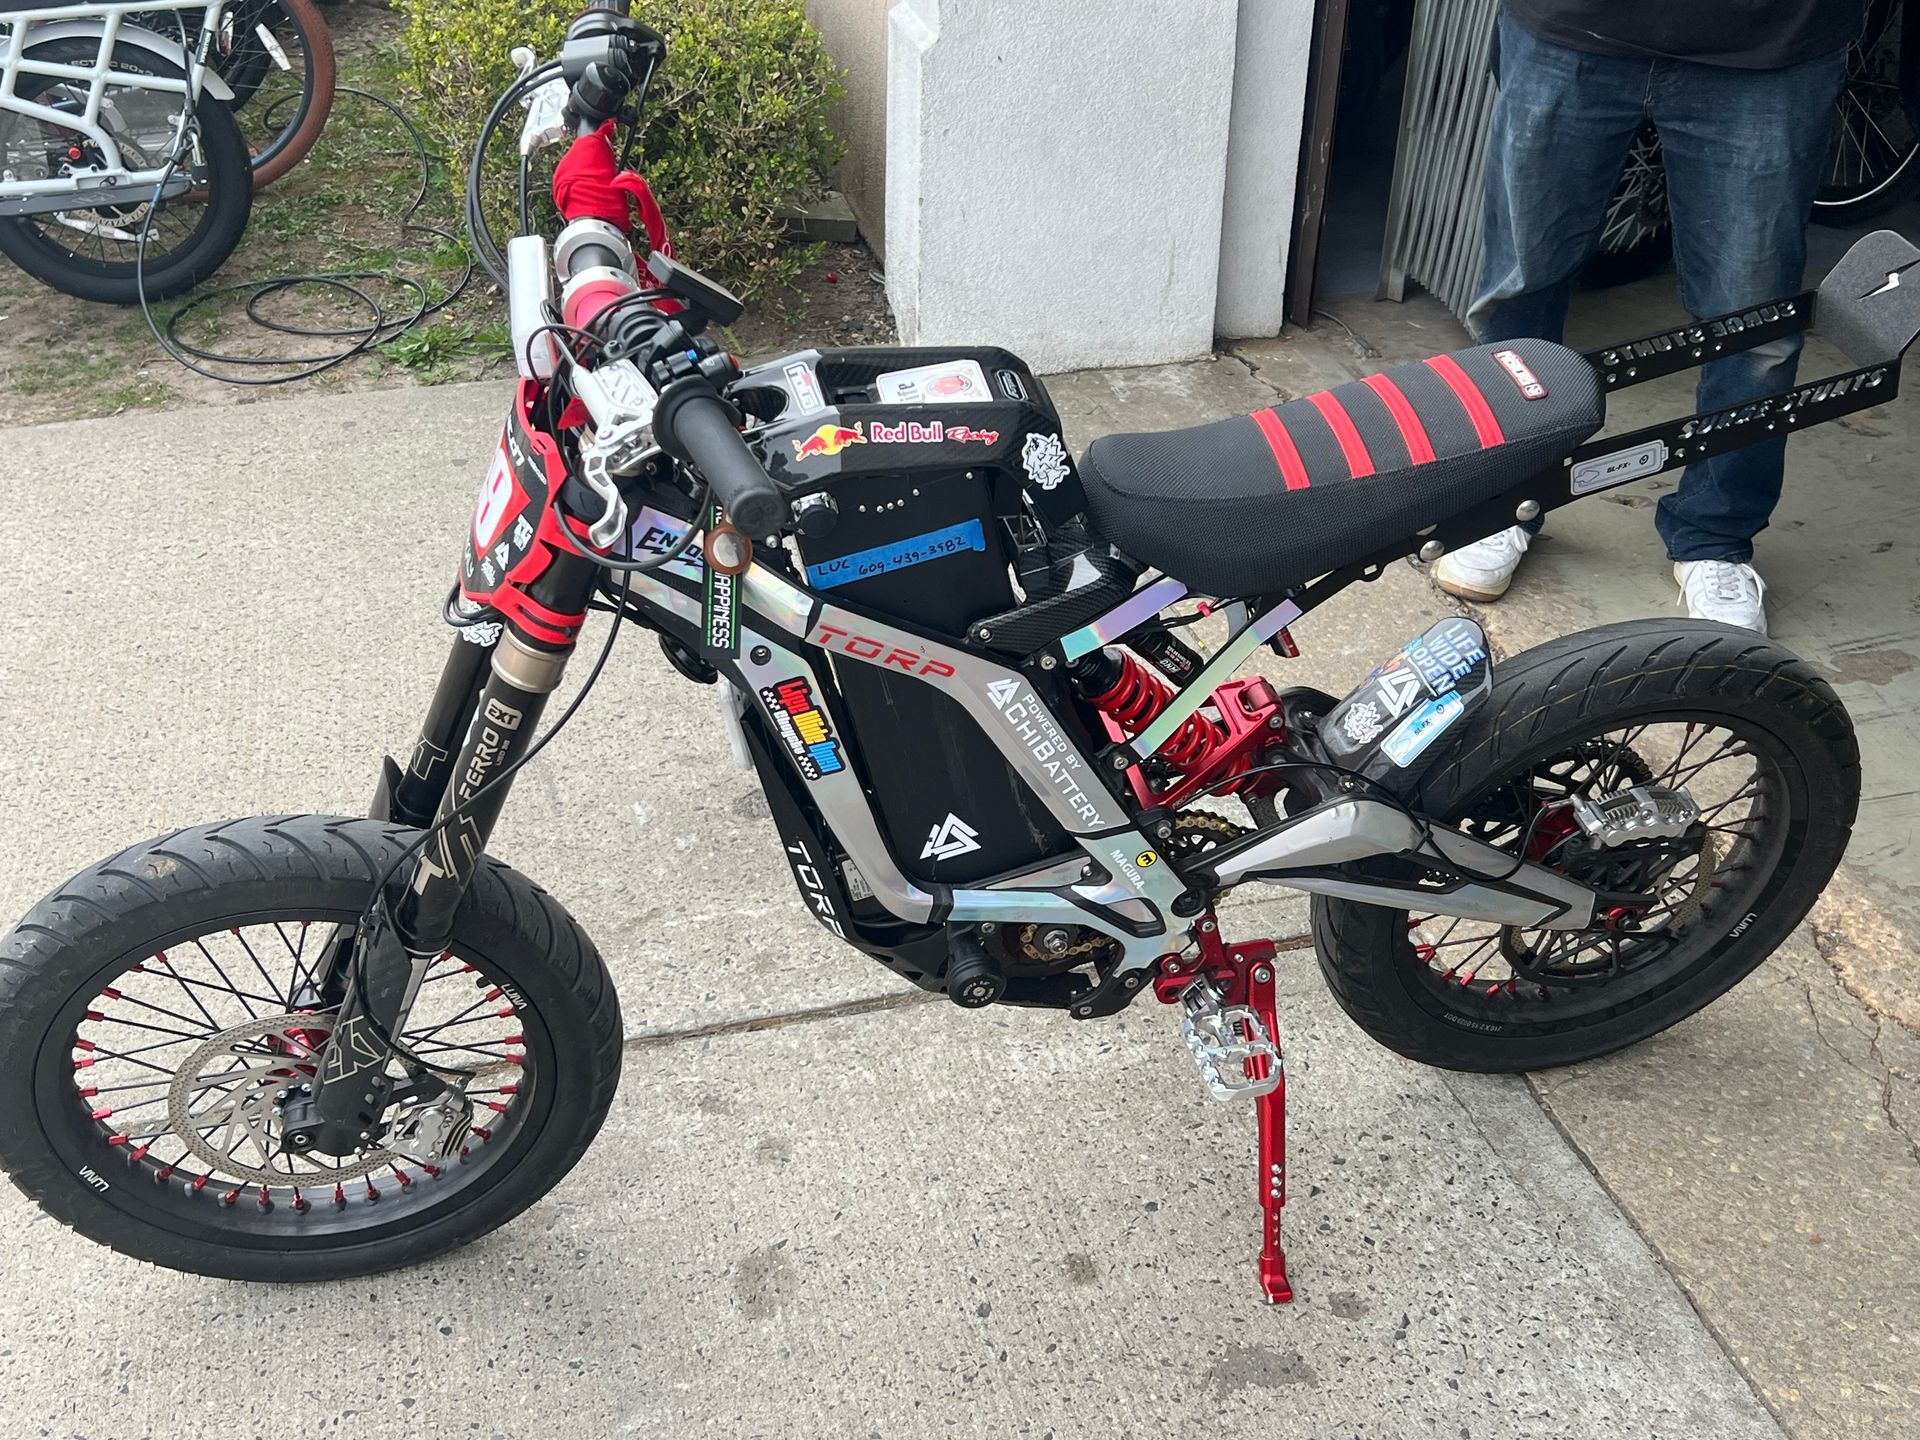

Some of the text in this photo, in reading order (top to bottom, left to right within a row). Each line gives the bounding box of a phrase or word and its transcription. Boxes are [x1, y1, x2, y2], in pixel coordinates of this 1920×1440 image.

[1776, 368, 1888, 412] STUNTS
[872, 421, 998, 446] Red Bull Racing
[818, 559, 850, 578] LUC
[712, 571, 730, 650] APPINESS
[820, 624, 956, 678] TORP
[1428, 634, 1472, 680] WIDE
[1446, 623, 1486, 665] LIFE
[1412, 648, 1456, 696] OPEN
[488, 701, 518, 726] EXT
[1022, 693, 1081, 770] POWERED BY
[459, 726, 499, 801] FERRO
[788, 841, 847, 938] TORP
[1110, 849, 1145, 890] MAGURA
